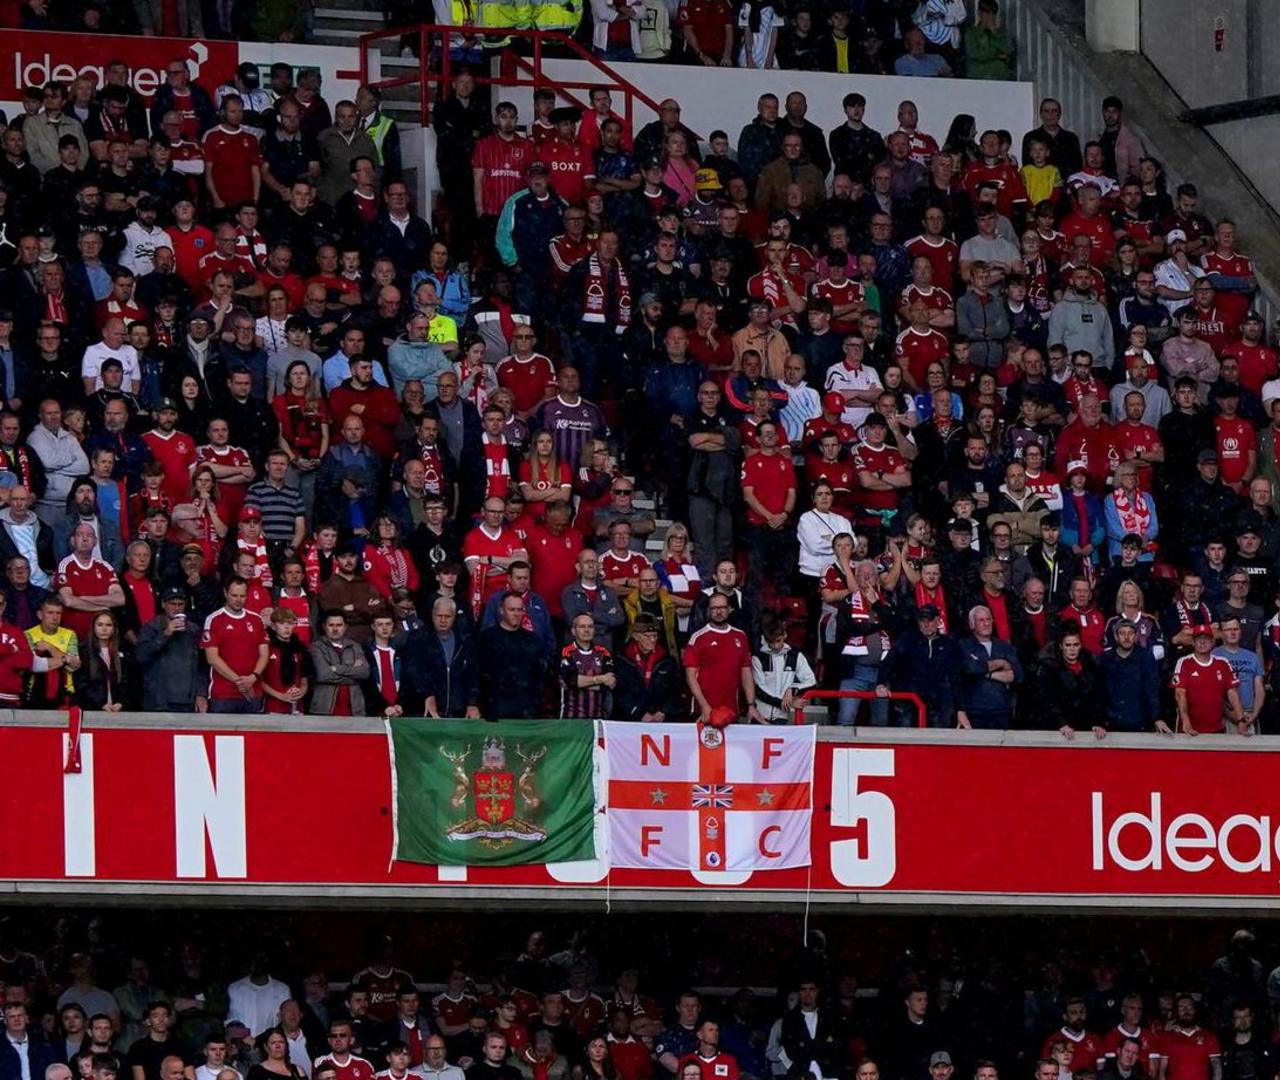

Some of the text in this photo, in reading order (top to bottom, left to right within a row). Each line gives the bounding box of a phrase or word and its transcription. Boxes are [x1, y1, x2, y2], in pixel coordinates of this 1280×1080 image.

[641, 735, 783, 769] N F
[640, 826, 780, 858] F C
